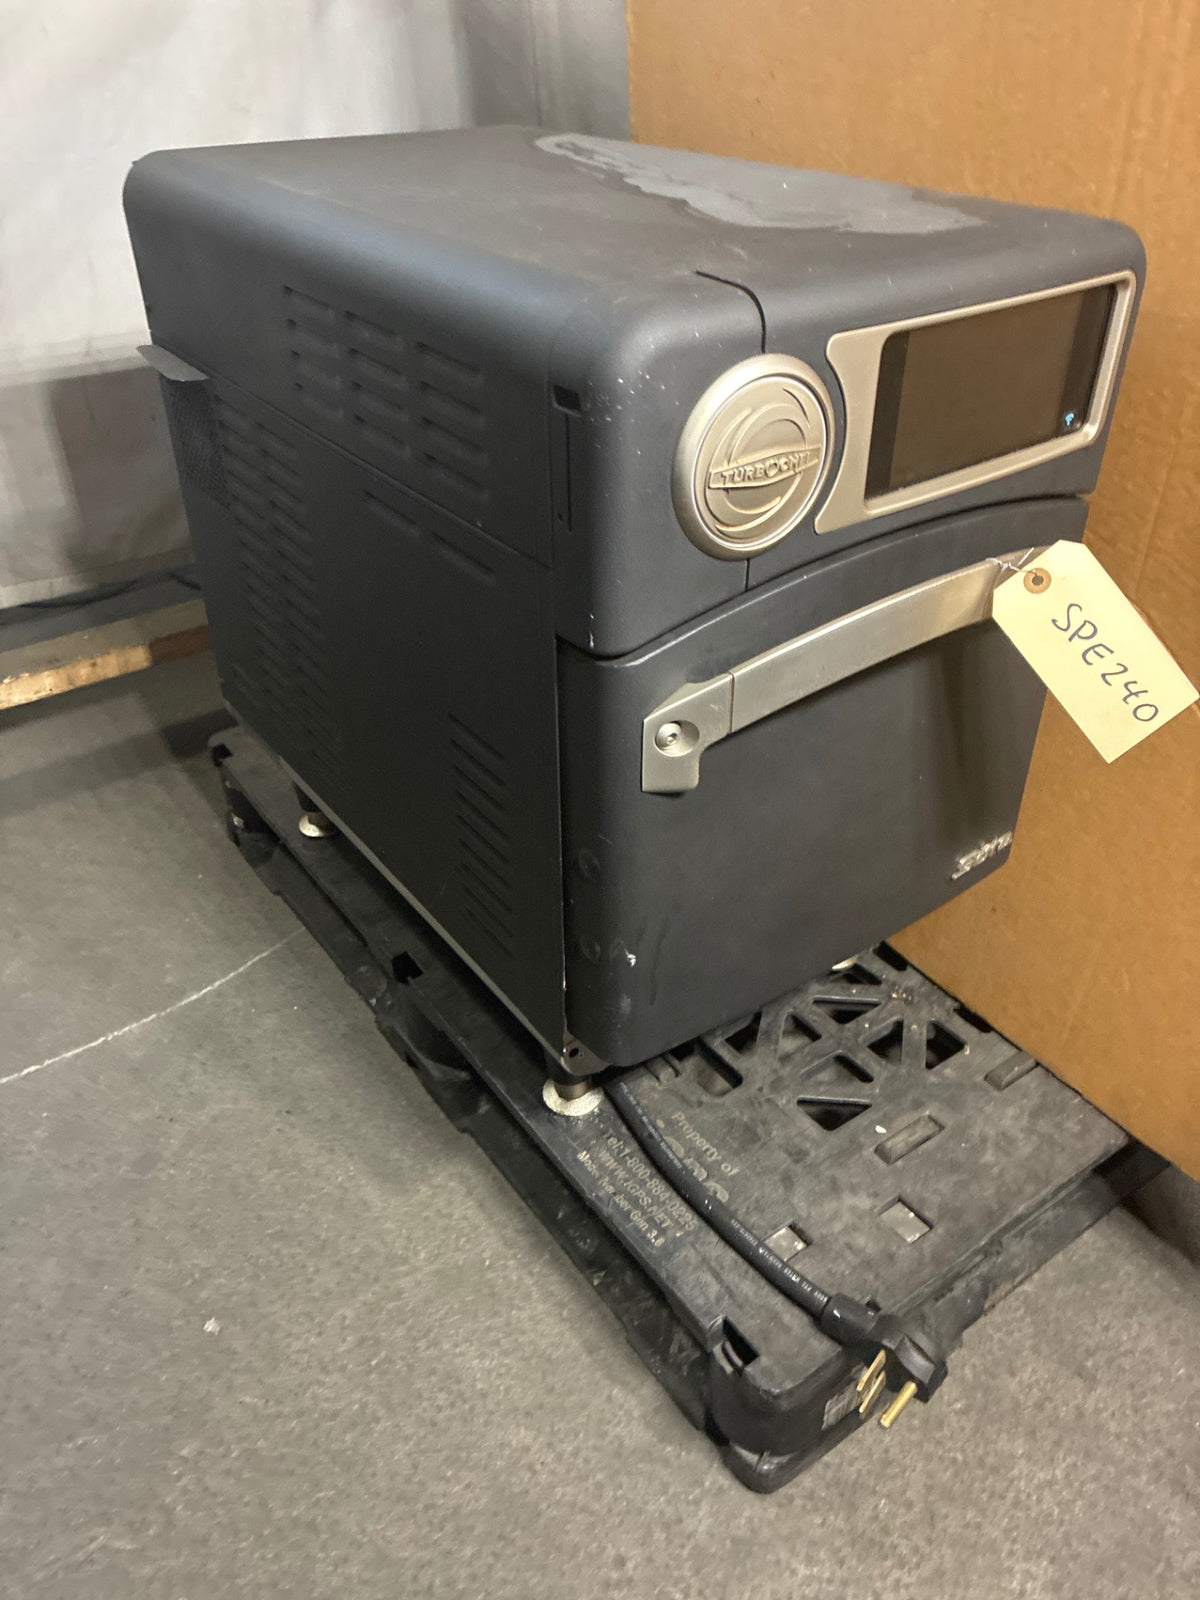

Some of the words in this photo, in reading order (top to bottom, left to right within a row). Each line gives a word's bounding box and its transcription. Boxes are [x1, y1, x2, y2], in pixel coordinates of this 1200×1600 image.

[1051, 603, 1159, 722] SPE240
[671, 1111, 722, 1162] Property
[721, 1162, 740, 1177] of
